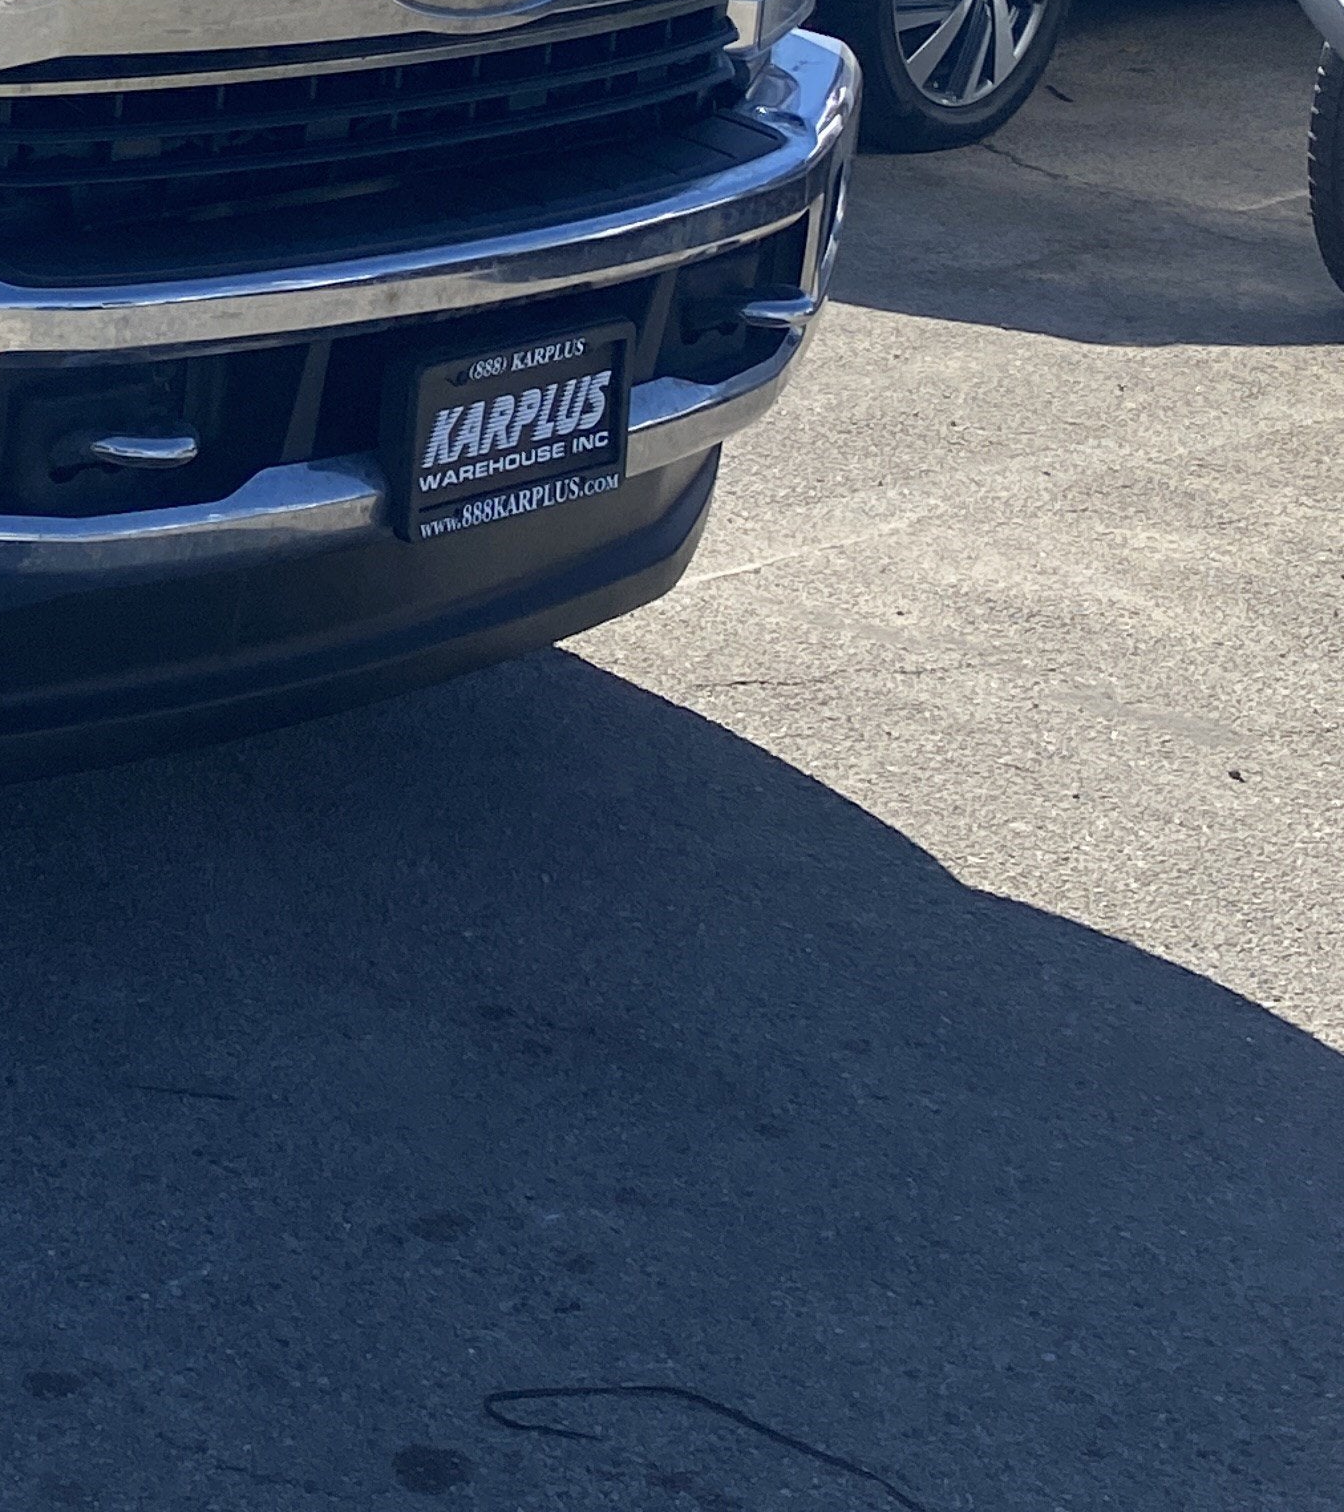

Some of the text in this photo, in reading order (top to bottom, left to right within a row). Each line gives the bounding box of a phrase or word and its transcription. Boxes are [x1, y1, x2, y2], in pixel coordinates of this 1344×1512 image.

[468, 338, 586, 381] (888) KARPLUS
[421, 370, 612, 469] KARPLUS
[419, 431, 610, 493] WAREHOUSE INC
